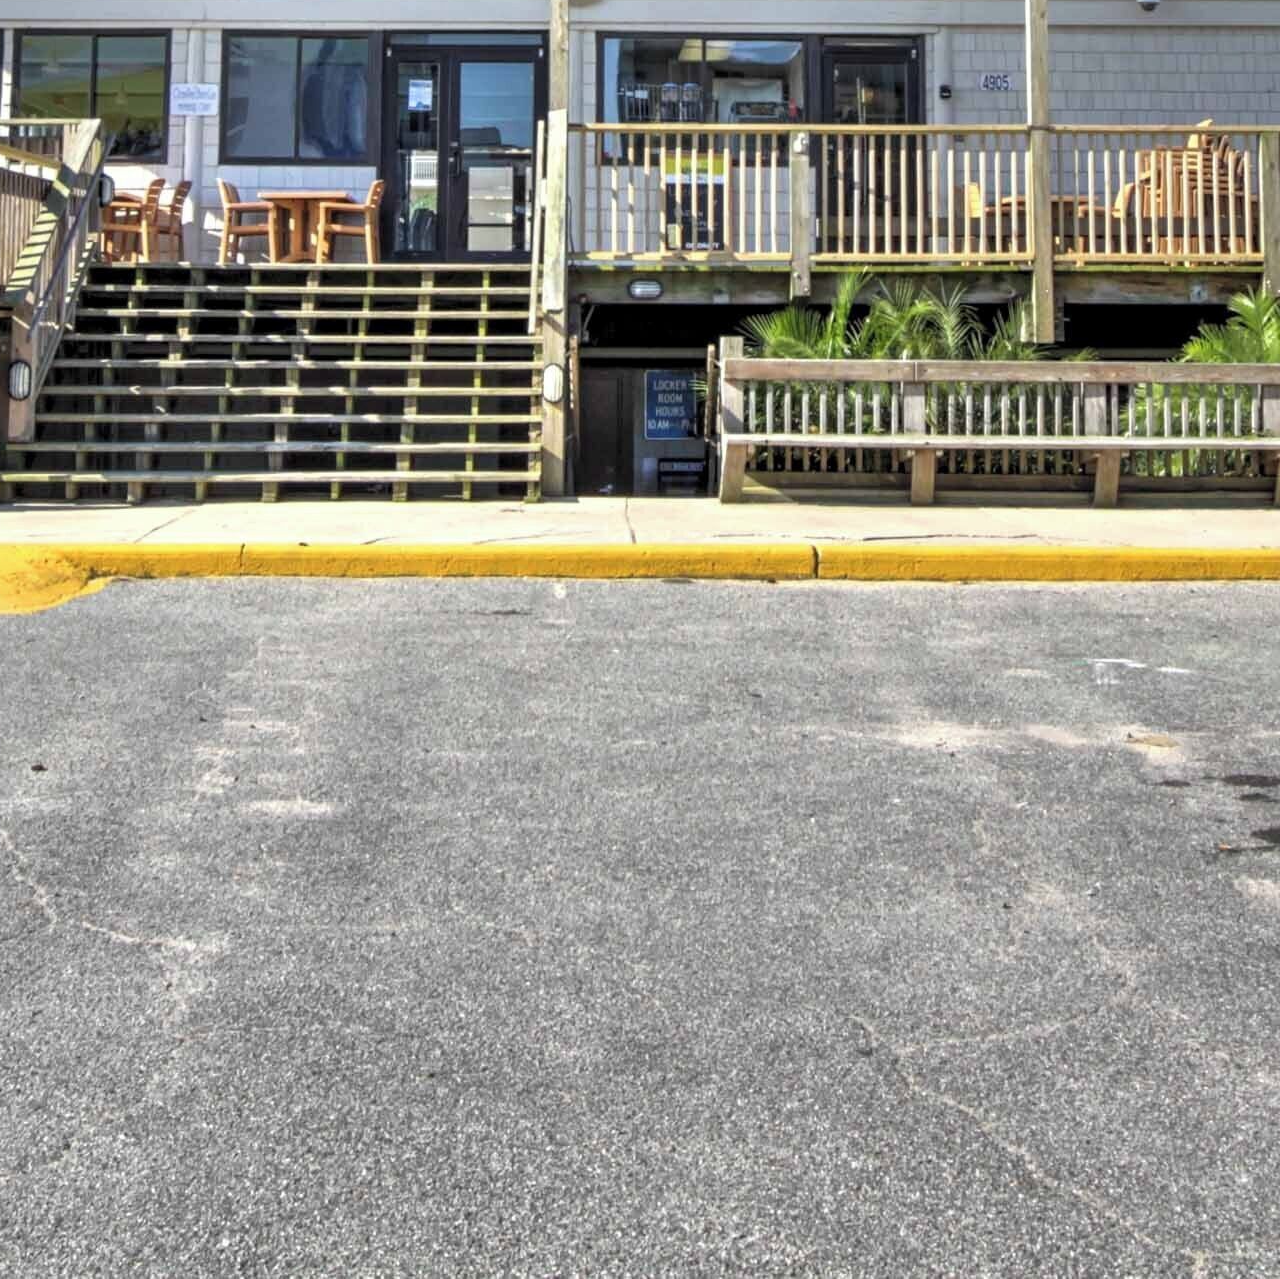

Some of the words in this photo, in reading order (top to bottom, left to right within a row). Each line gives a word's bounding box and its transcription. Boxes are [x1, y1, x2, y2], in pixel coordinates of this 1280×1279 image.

[983, 74, 1009, 91] 4905
[653, 379, 688, 391] LOCKER
[657, 393, 683, 404] ROOM
[655, 406, 686, 417] HOURS
